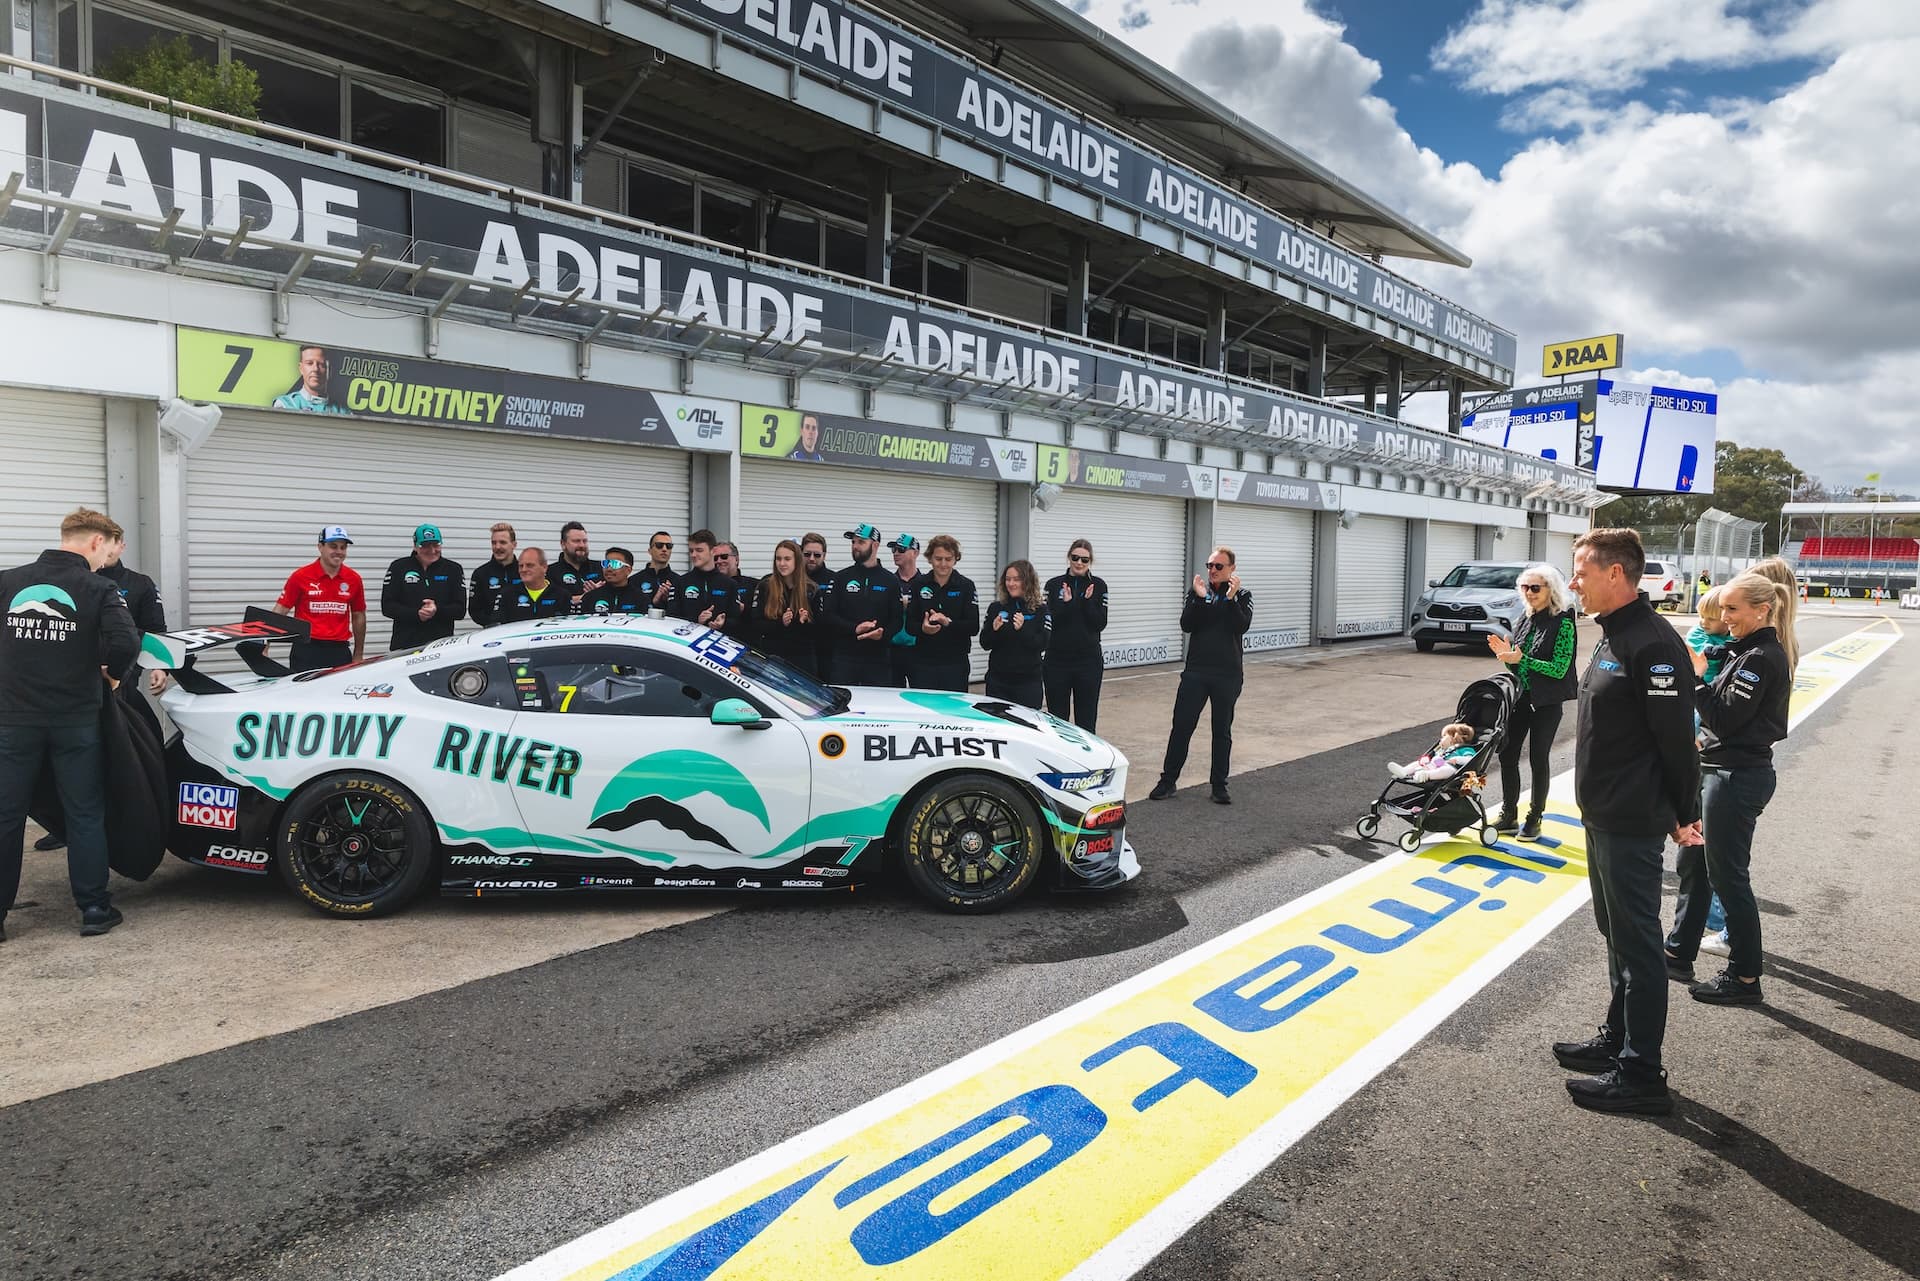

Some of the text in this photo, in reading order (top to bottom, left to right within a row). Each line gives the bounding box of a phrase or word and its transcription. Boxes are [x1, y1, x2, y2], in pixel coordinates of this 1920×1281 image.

[957, 76, 1119, 189] ADELAIDE
[1145, 167, 1257, 250] ADELAIDE
[1276, 231, 1358, 295] ADELAIDE
[469, 221, 823, 349] ADELAIDE
[1372, 276, 1434, 329] ADELAIDE
[1444, 312, 1494, 356] ADELAIDE
[881, 315, 1080, 399] ADELAIDE
[1565, 343, 1608, 367] RAA
[218, 344, 254, 394] 7
[339, 356, 399, 381] JAMES
[347, 377, 504, 424] COURTNEY
[1115, 370, 1246, 430] ADELAIDE
[1475, 394, 1513, 408] ADELAIDE
[1541, 384, 1584, 398] ADELAIDE
[505, 395, 585, 419] SNOWY RIVER
[1650, 395, 1674, 409] FIBRE
[1677, 398, 1690, 411] HD
[1691, 400, 1707, 413] SDI
[505, 411, 551, 429] RACING
[686, 408, 724, 426] ADL
[1266, 405, 1359, 448] ADELAIDE
[1508, 414, 1532, 426] FIBRE
[1534, 413, 1547, 424] HD
[1549, 410, 1566, 421] SDI
[697, 425, 723, 440] GF
[759, 414, 779, 448] 3
[820, 427, 950, 465] AARON CAMERON
[949, 442, 976, 457] REDARC
[1005, 448, 1028, 462] ADL
[1374, 430, 1442, 465] ADELAIDE
[1579, 424, 1594, 467] RAA
[949, 452, 973, 467] RACING
[1011, 461, 1027, 473] GF
[1048, 451, 1060, 478] 5
[1452, 447, 1505, 475] ADELAIDE
[1085, 465, 1126, 487] CINDRIC
[1512, 461, 1554, 483] ADELAIDE
[1256, 481, 1280, 498] TOYOTA
[1289, 485, 1309, 501] SUPRA
[1830, 588, 1851, 597] RAA
[7, 616, 77, 631] SNOWY RIVER
[15, 627, 66, 641] RACING
[1336, 620, 1395, 635] GLIDEROL GARAGE DOORS
[543, 633, 606, 641] COURTNEY
[1252, 634, 1278, 648] GARAGE
[1278, 632, 1299, 646] DOORS
[1103, 645, 1168, 665] GARAGE DOORS
[695, 655, 751, 690] invenio
[558, 685, 577, 713] 7
[918, 723, 975, 732] THANKS
[233, 711, 583, 800] SNOWY RIVER
[864, 734, 1008, 762] BLAHST
[182, 784, 236, 808] LIQUI
[346, 779, 413, 813] DUNLOP
[182, 804, 235, 828] MOLY
[909, 793, 939, 856] DUNLOP
[206, 844, 269, 864] FORD
[450, 855, 511, 866] THANKS
[836, 835, 873, 867] 7
[204, 857, 266, 871] PERFORMANCE
[821, 867, 849, 877] Repco
[473, 877, 823, 888] invenio EventR DesignEars sparco
